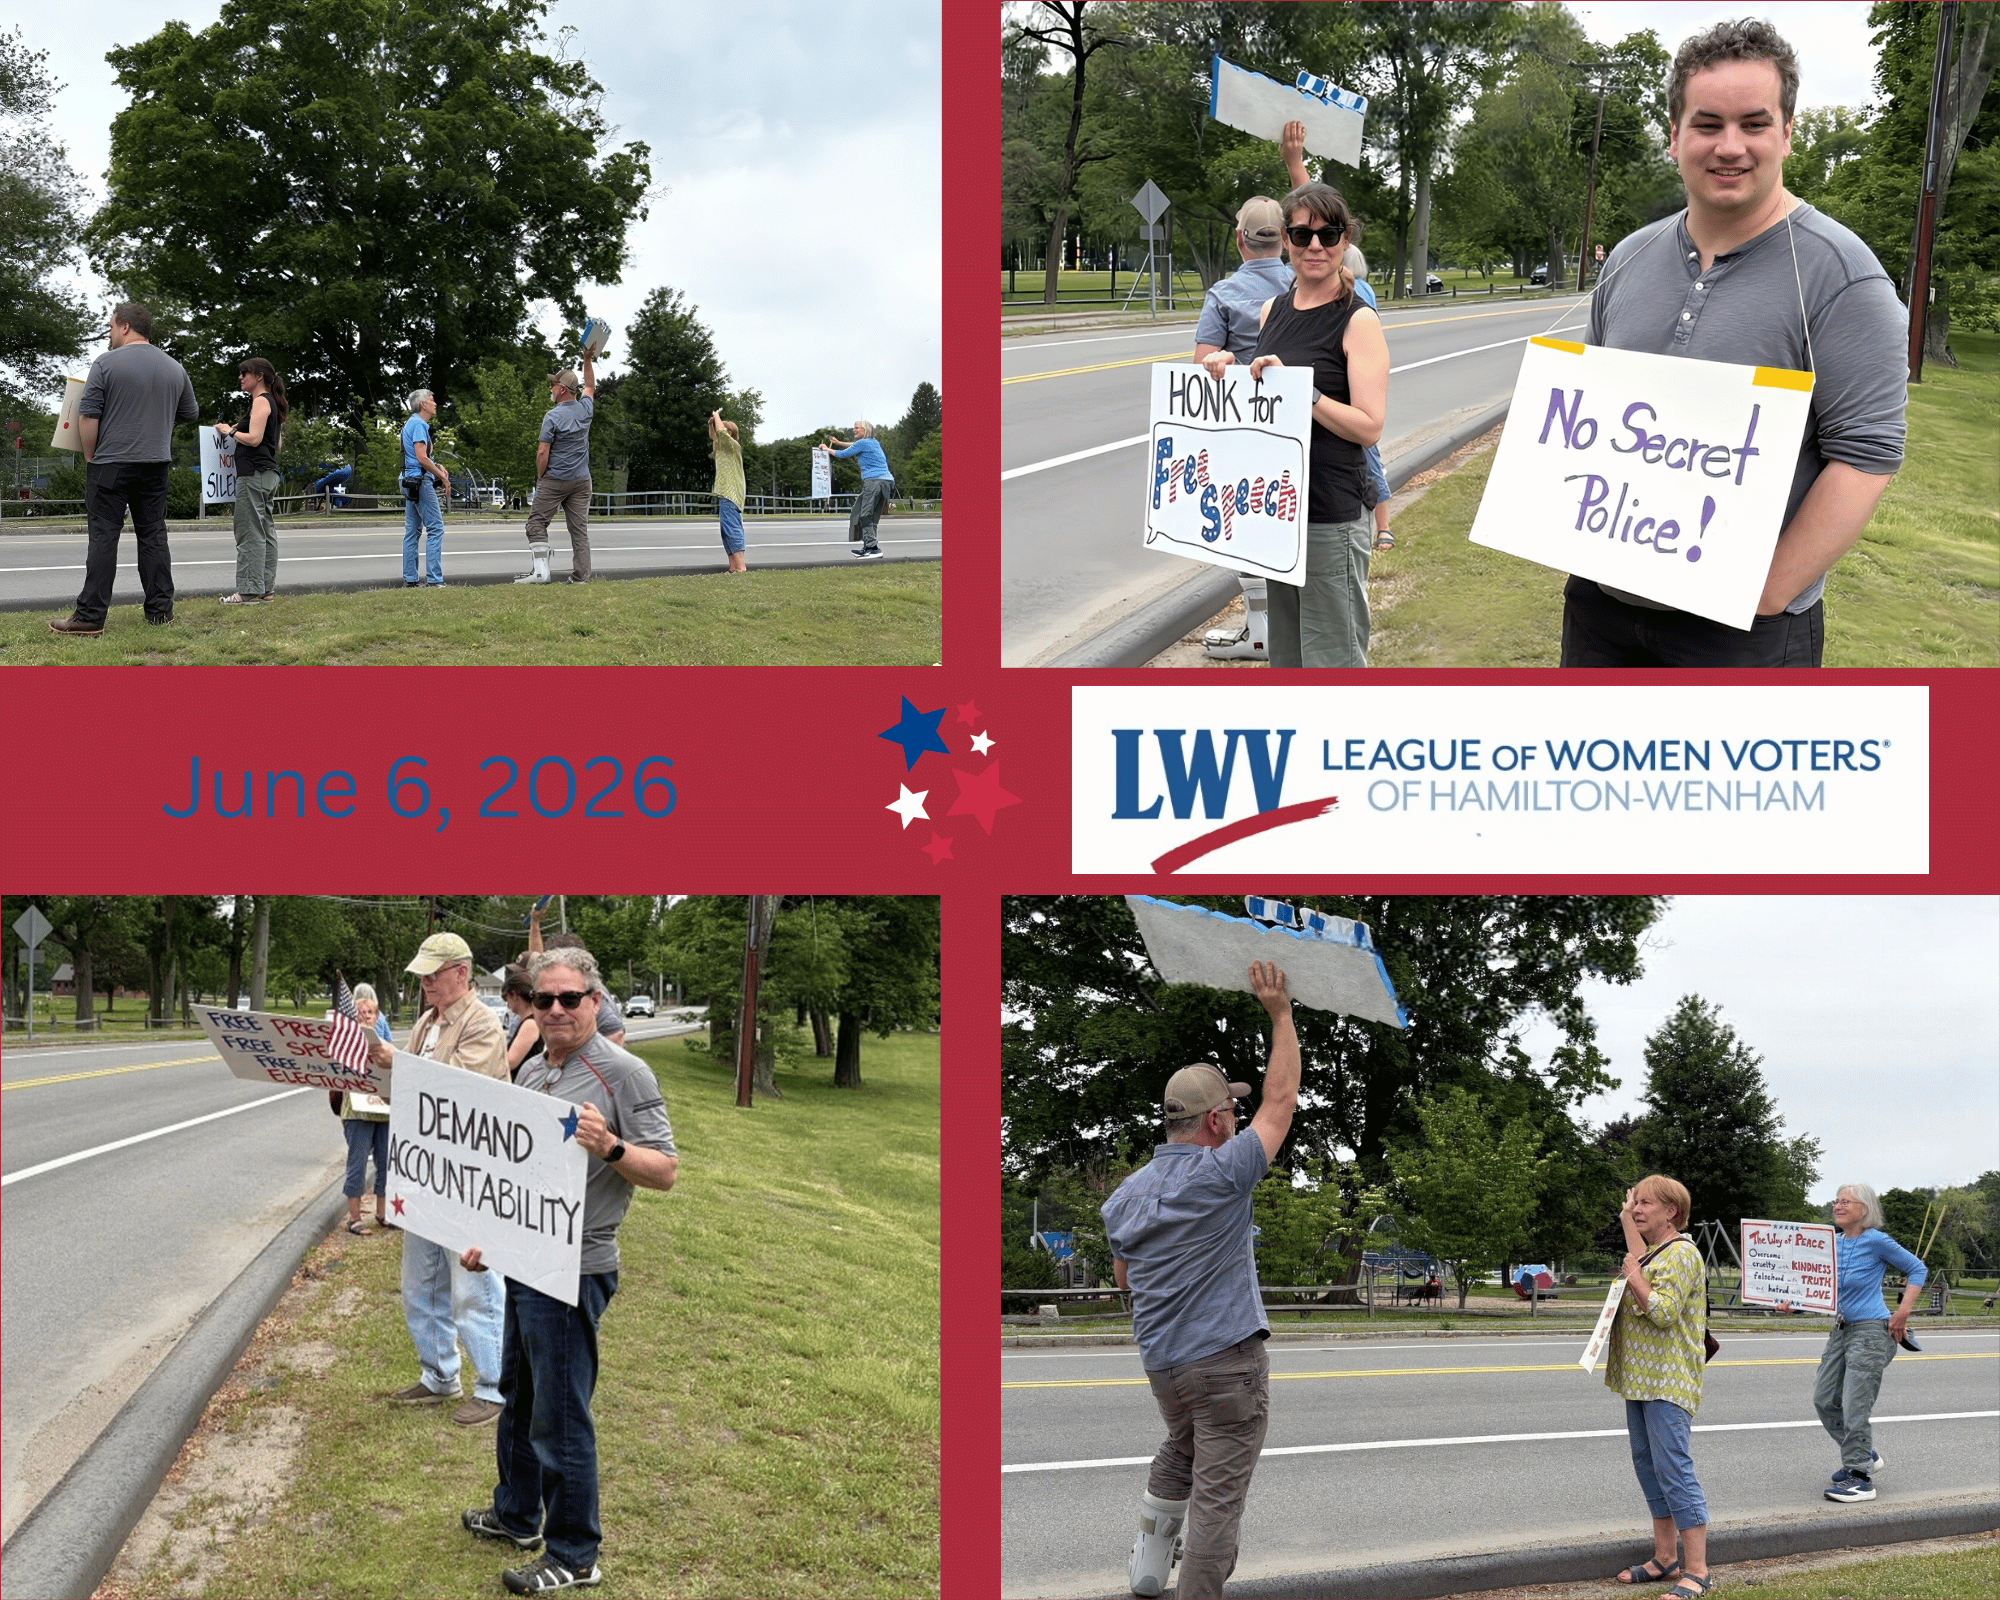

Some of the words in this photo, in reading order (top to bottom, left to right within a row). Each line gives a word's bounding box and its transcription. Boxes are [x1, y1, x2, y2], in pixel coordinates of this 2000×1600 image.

[1169, 370, 1242, 423] HONK
[1248, 377, 1283, 424] for
[1538, 388, 1598, 450] No
[1610, 402, 1761, 486] Secret
[219, 454, 235, 468] NOT
[1153, 436, 1210, 510] Free
[1200, 470, 1297, 543] Speech
[1564, 474, 1716, 563] Police!
[207, 1012, 263, 1031] FREE
[269, 1018, 332, 1039] PRES
[221, 1035, 275, 1052] FREE
[254, 1054, 301, 1070] FREE
[268, 1068, 378, 1094] ELECTIONS
[419, 1092, 533, 1163] DEMAND
[387, 1133, 581, 1245] ACCOUNTABILITY
[1749, 1230, 1766, 1245] The
[1767, 1233, 1782, 1248] Way
[1784, 1234, 1792, 1244] of
[1752, 1261, 1776, 1270] cruelty
[1791, 1261, 1831, 1274] KINDNESS
[1801, 1275, 1832, 1287] TRUTH
[1805, 1288, 1831, 1299] LOVE
